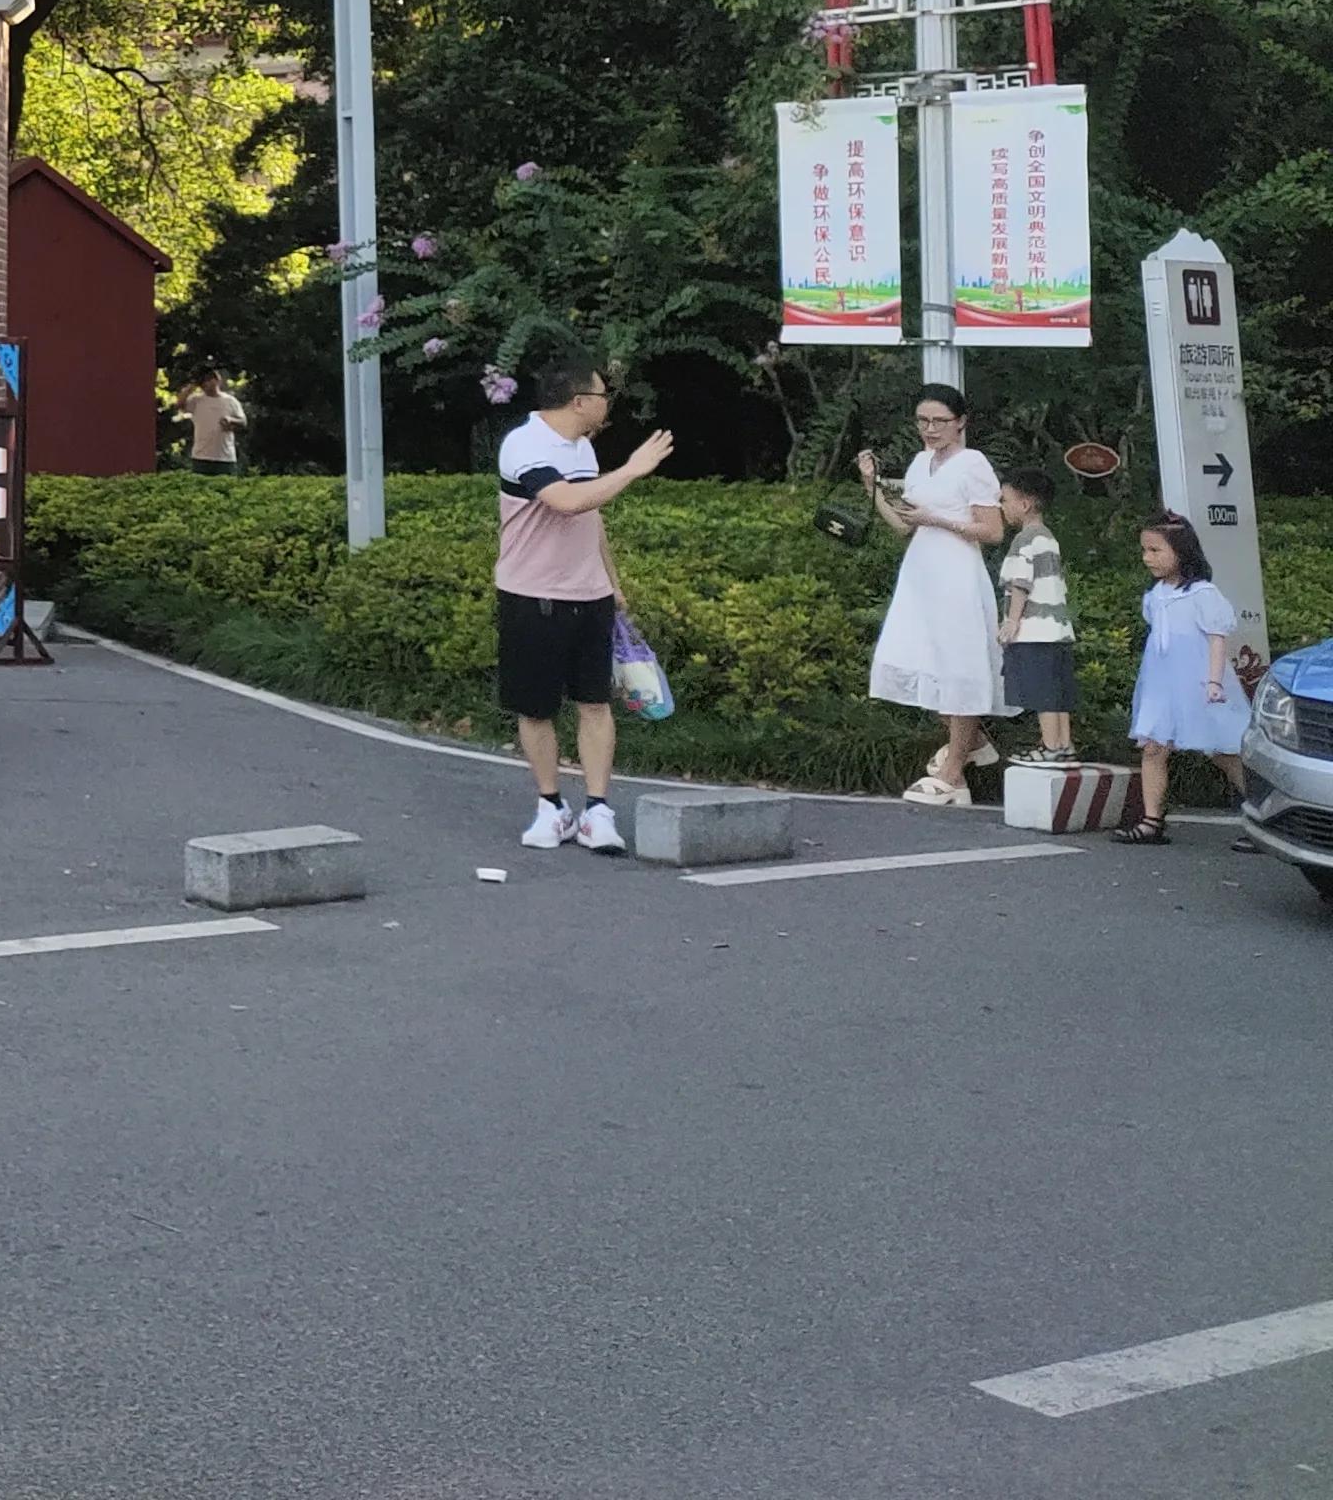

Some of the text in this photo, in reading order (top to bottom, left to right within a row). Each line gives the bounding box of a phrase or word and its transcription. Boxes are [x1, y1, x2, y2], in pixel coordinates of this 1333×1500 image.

[813, 163, 832, 285] 争做环保公民
[847, 139, 866, 263] 提高环保意识
[1028, 129, 1047, 280] 争创全国文明典范城市
[1179, 343, 1235, 367] 旅游厕所
[1208, 507, 1238, 523] 100m
